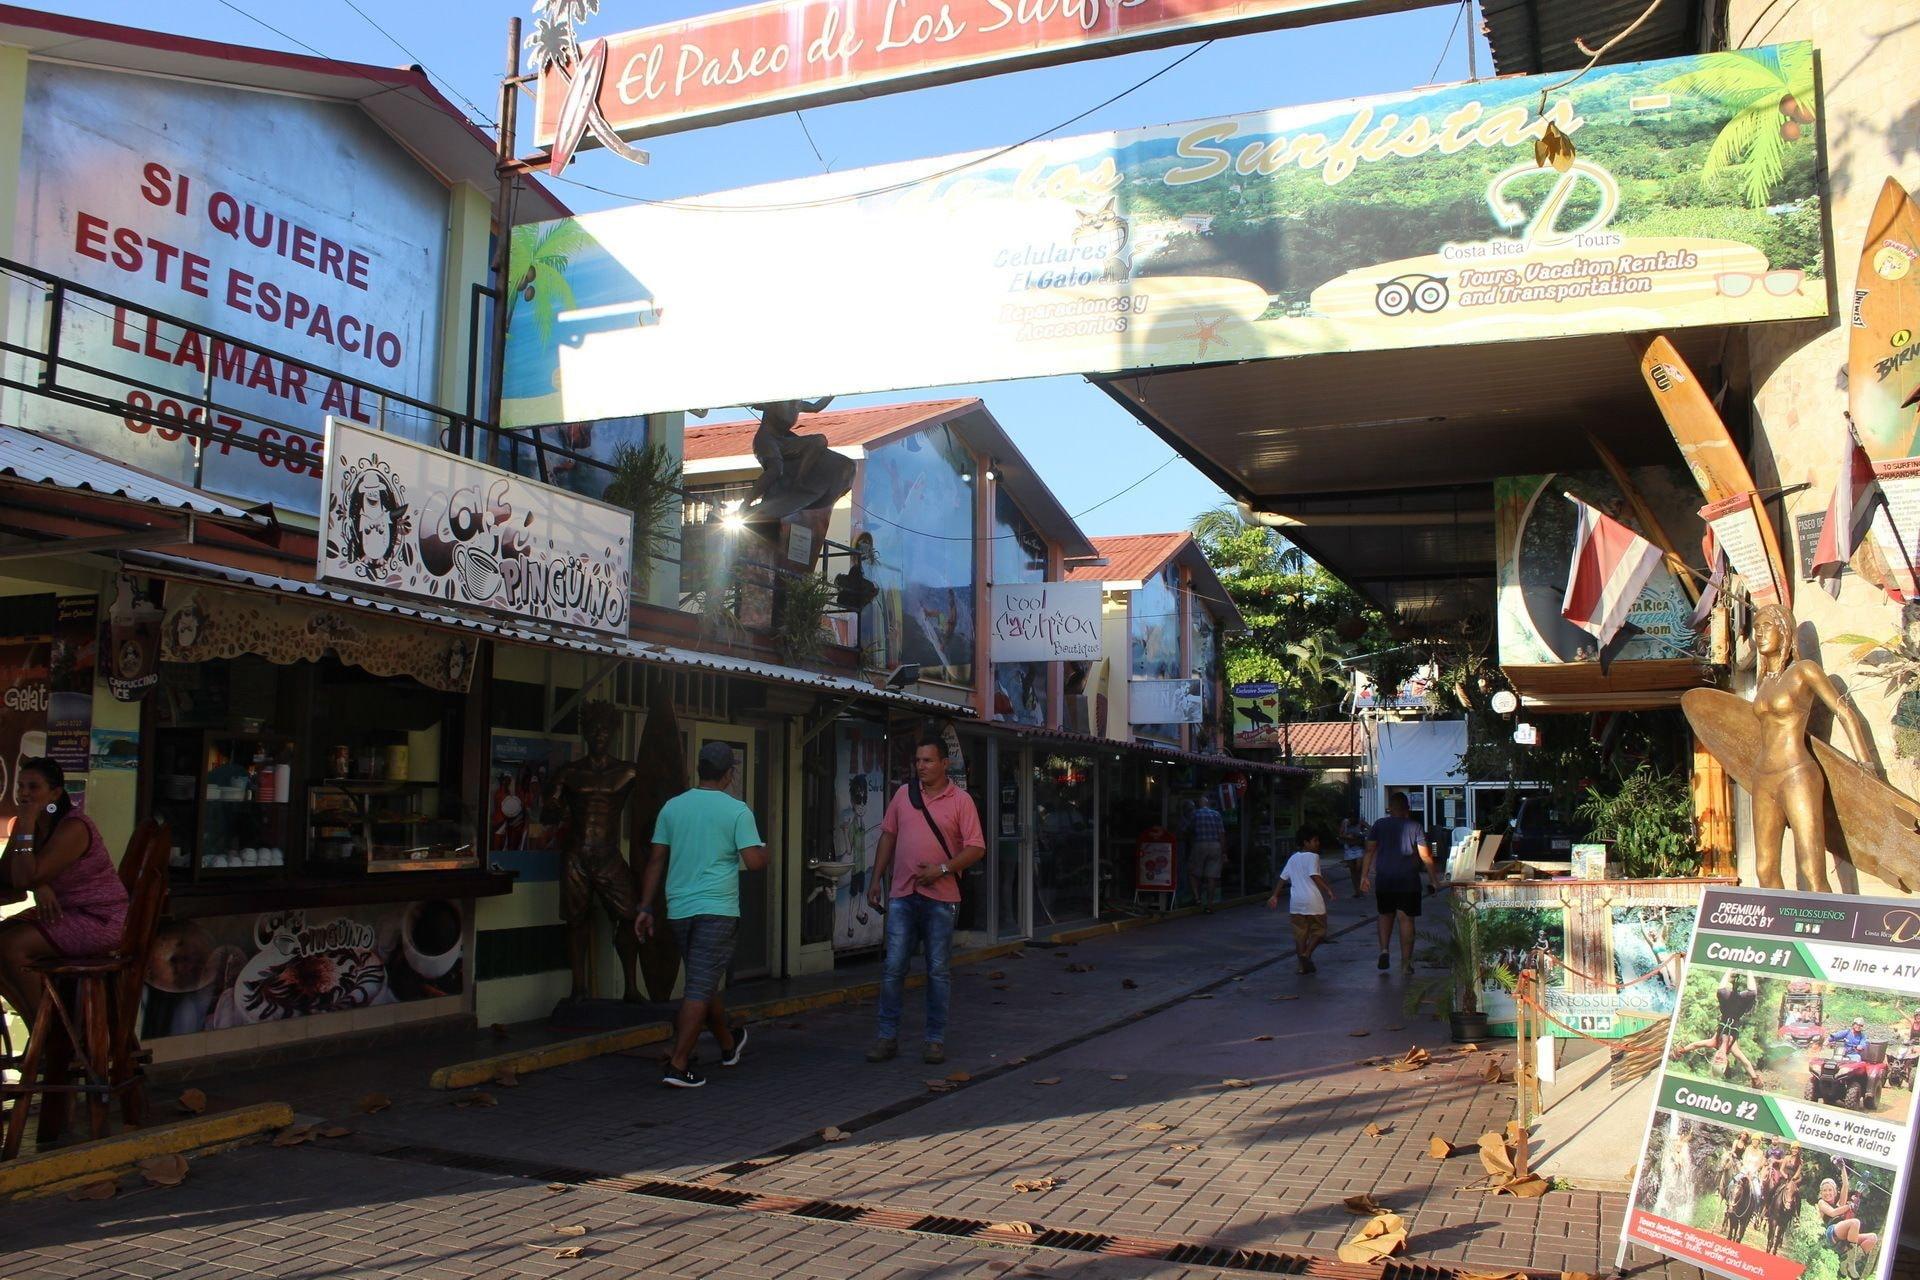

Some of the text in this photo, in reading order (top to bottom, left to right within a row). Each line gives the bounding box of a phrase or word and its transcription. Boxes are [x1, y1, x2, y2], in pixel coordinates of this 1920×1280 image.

[617, 53, 666, 105] El
[673, 45, 790, 97] Paseo
[806, 23, 865, 64] de
[873, 0, 967, 60] Los
[1163, 97, 1586, 186] Surfistas
[140, 162, 370, 291] SI QUIERE
[993, 242, 1107, 268] Celulares
[1443, 230, 1621, 261] Costa Rica Tours
[1036, 265, 1092, 289] Gato
[1459, 247, 1698, 289] Tours, Vacation Rentals
[75, 211, 402, 369] ESTE ESPACIO
[1132, 294, 1149, 315] y
[1458, 274, 1652, 307] and Transportation
[112, 305, 371, 424] LLAMAR AL
[500, 556, 626, 628] PINGÜINO
[108, 673, 158, 688] CAPPUCCINO
[113, 689, 130, 699] ICE
[1709, 913, 1774, 928] COMBOS BY
[1718, 902, 1766, 916] PREMIUM
[1779, 907, 1798, 916] VISTA
[1706, 941, 1792, 968] Combo #1
[1831, 957, 1920, 979] Zip line + ATV
[1675, 1087, 1758, 1121] Combo #2
[1794, 1110, 1897, 1143] Zip line + Waterfalls
[1798, 1124, 1892, 1156] Horseback Riding
[1683, 1229, 1714, 1248] bilingual
[1704, 1249, 1726, 1263] water
[1725, 1255, 1742, 1268] and
[1741, 1261, 1765, 1277] lunch.
